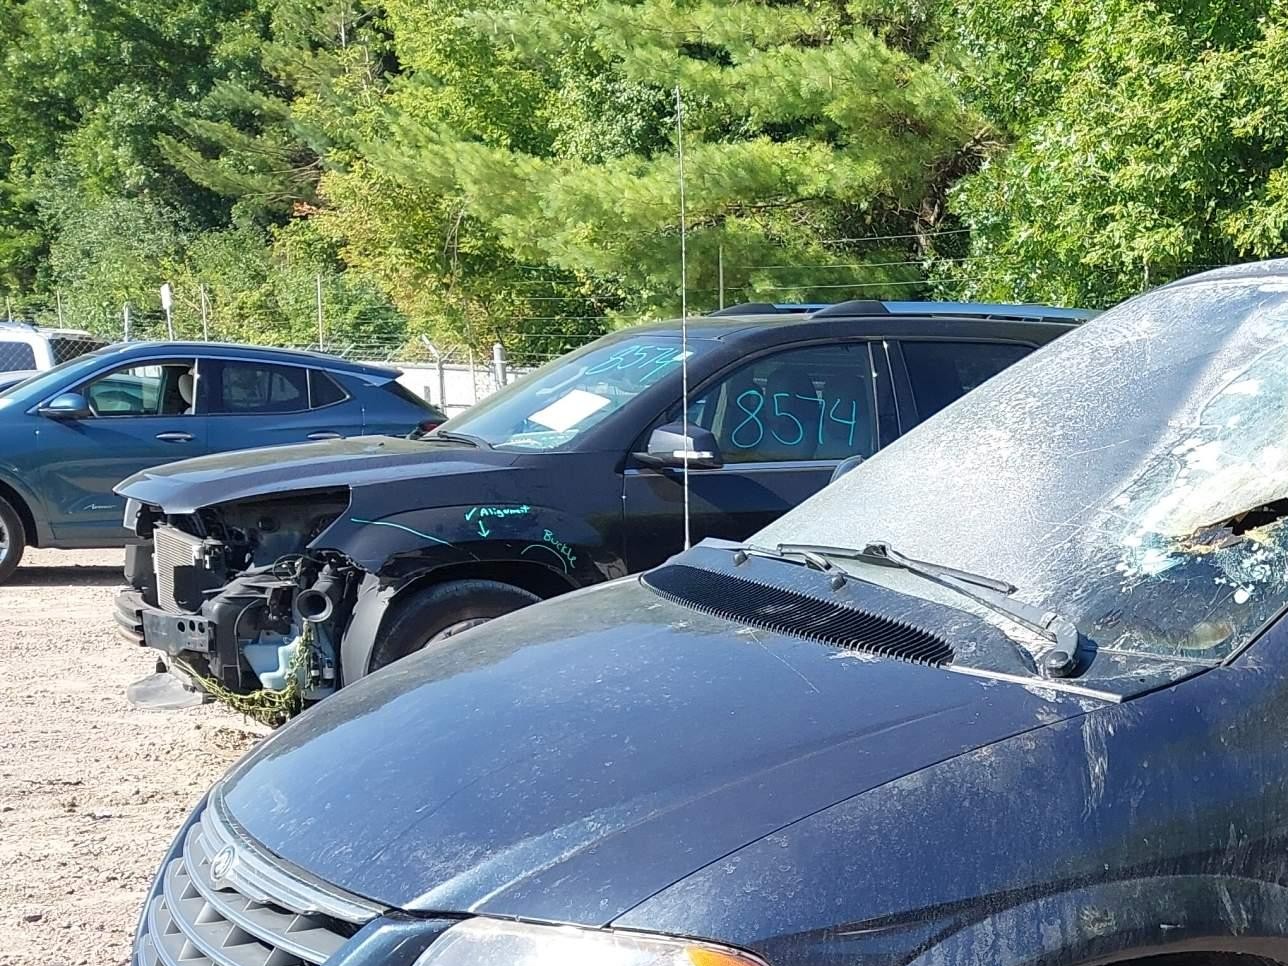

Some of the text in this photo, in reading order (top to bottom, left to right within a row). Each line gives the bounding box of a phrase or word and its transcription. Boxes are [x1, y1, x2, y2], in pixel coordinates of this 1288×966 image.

[585, 345, 680, 382] 8574
[732, 390, 856, 448] 8574
[543, 529, 577, 569] Buckle
